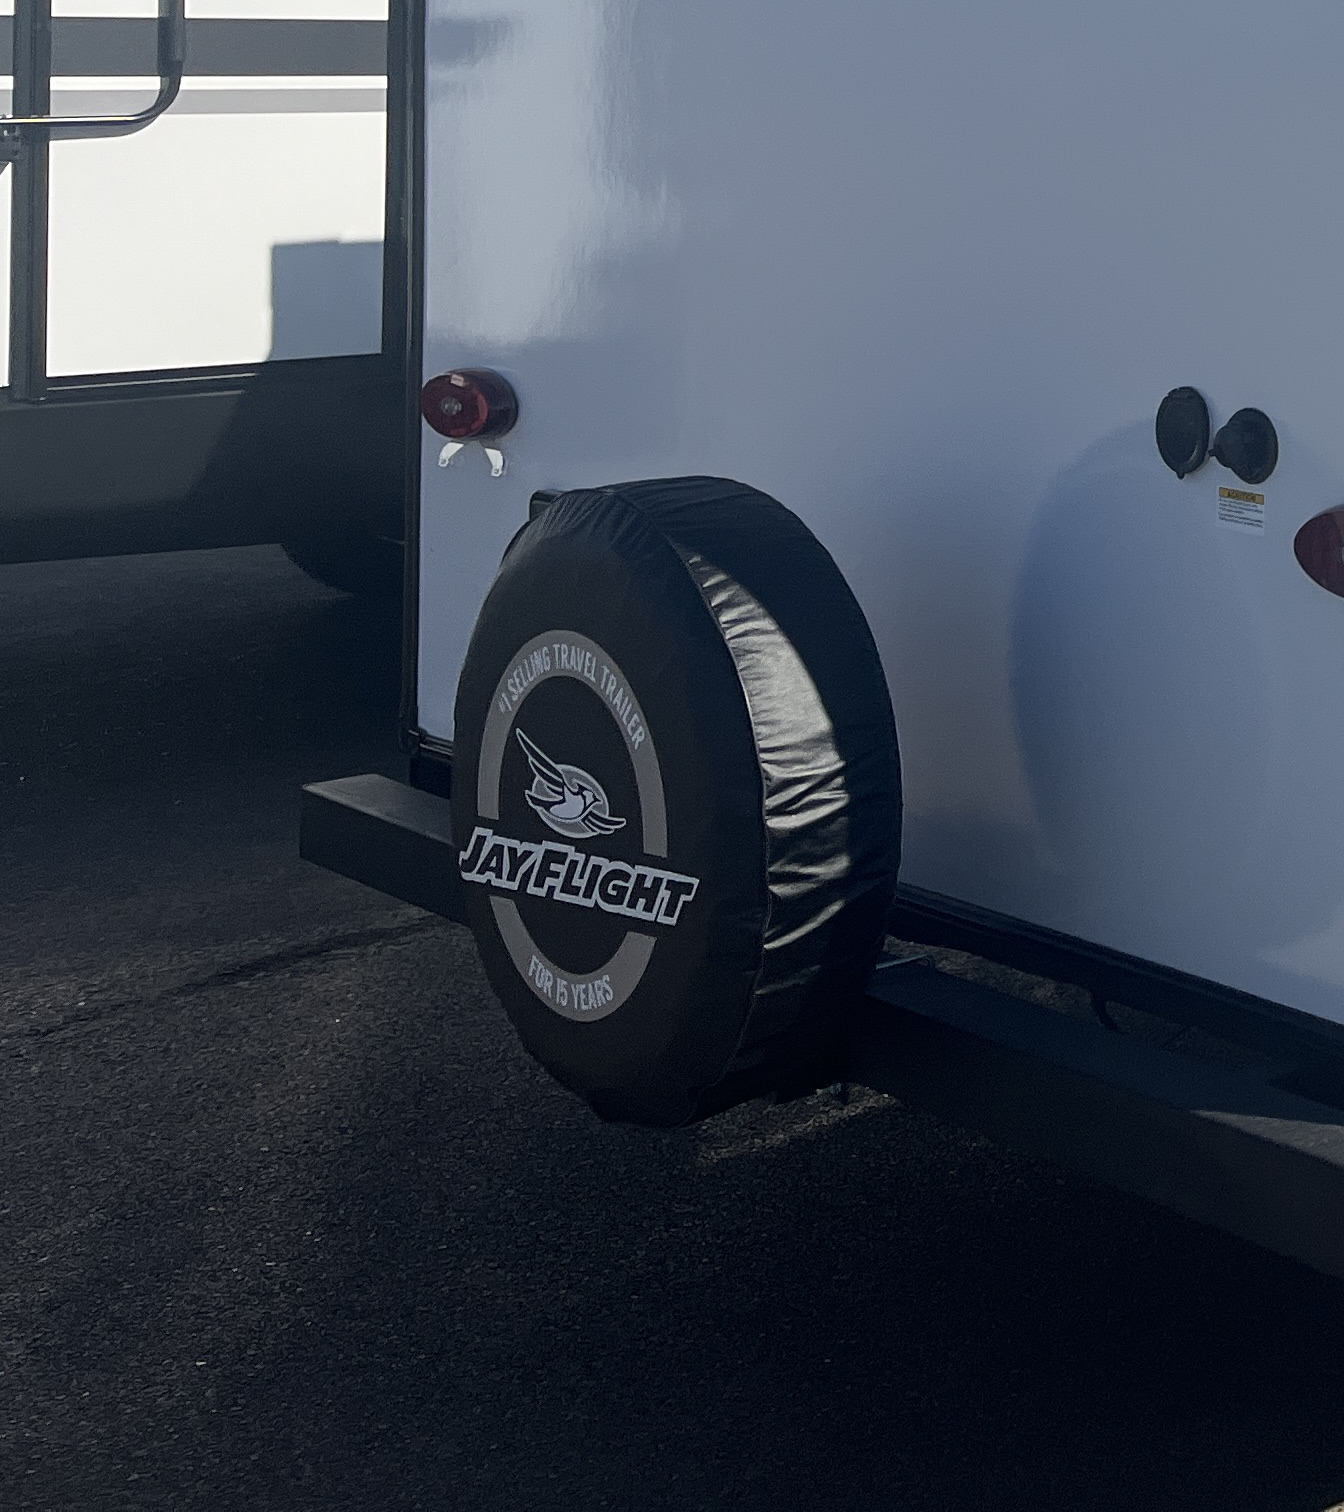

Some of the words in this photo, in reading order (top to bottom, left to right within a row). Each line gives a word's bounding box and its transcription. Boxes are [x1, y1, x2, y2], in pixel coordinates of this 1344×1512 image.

[507, 646, 550, 702] SELLING
[552, 643, 597, 683] TRAVEL
[600, 665, 646, 750] TRAILER
[528, 955, 554, 997] FOR
[555, 977, 568, 1007] 15
[571, 974, 614, 1011] YEARS
